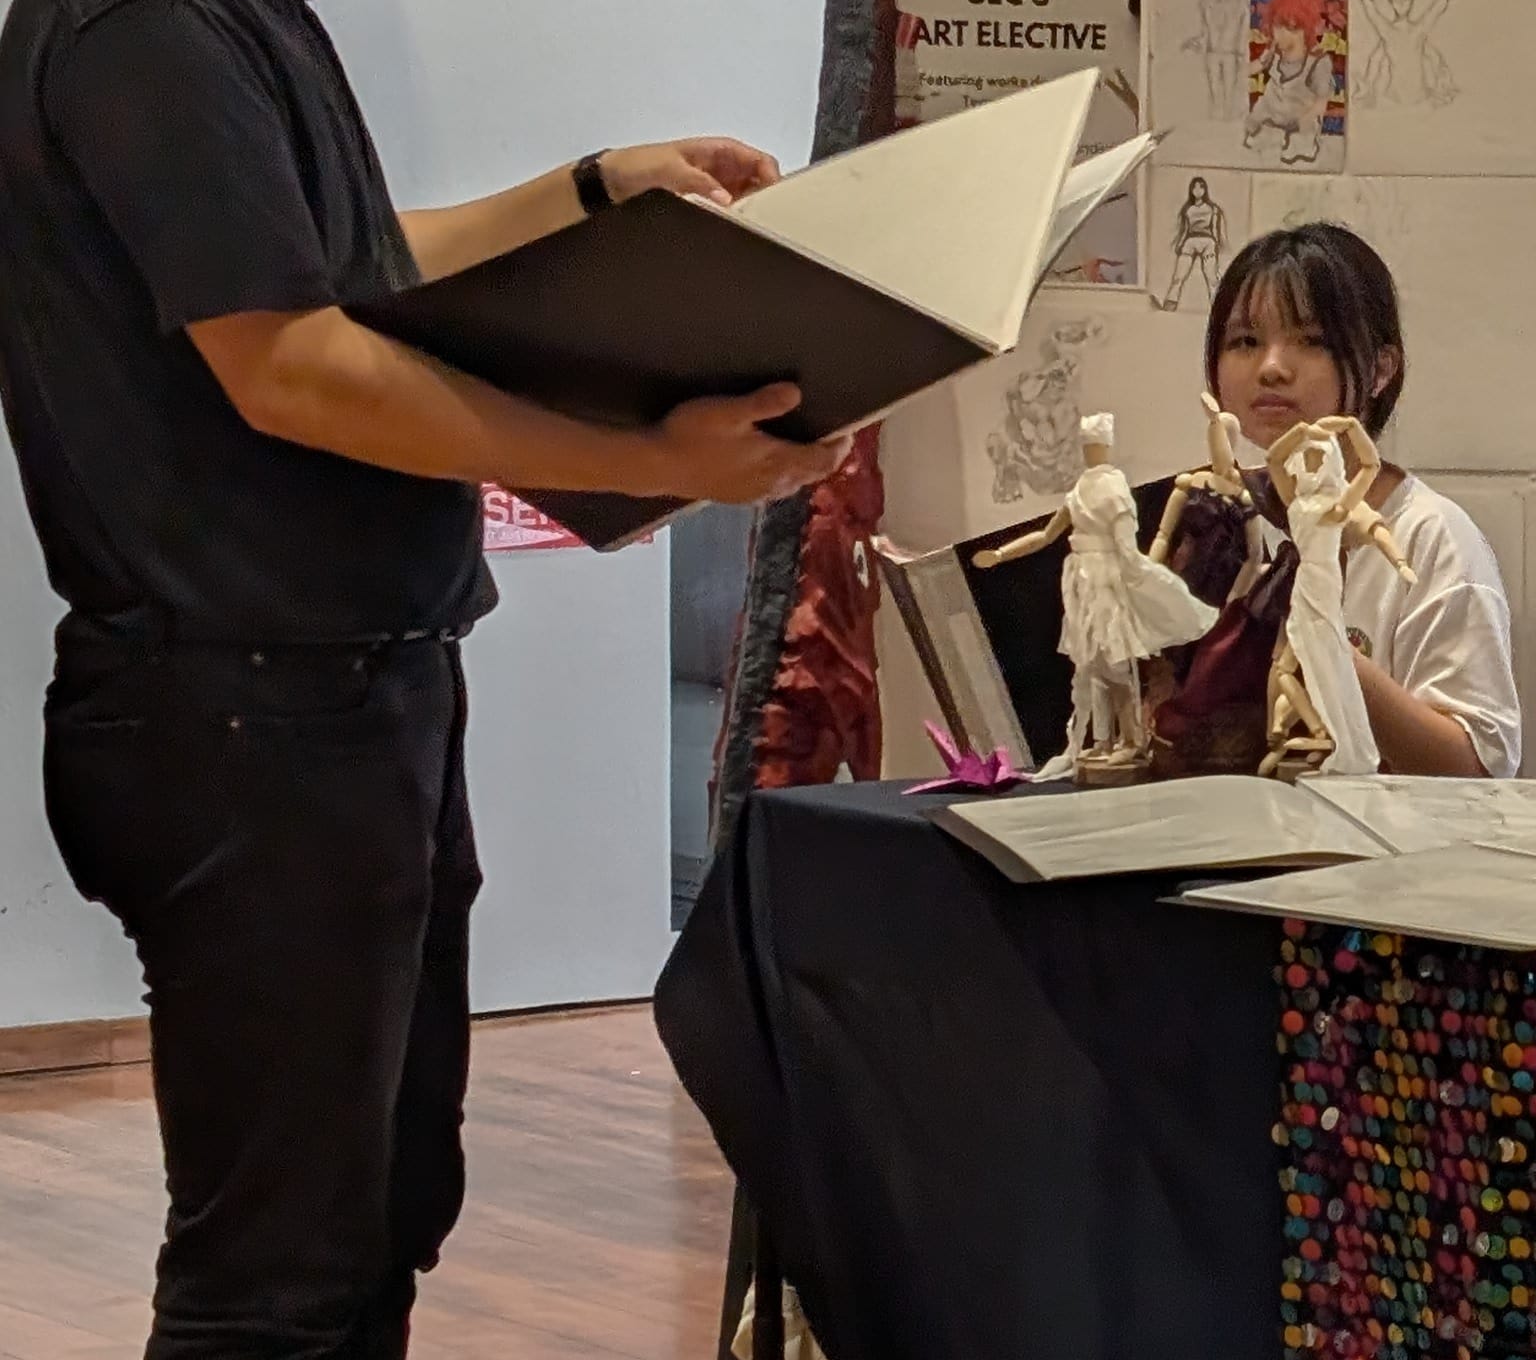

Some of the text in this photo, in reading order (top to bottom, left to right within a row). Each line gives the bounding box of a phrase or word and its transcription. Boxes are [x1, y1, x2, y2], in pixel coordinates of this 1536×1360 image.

[917, 17, 1107, 50] ART ELECTIVE
[919, 72, 984, 90] Featuring
[483, 490, 549, 525] SE
